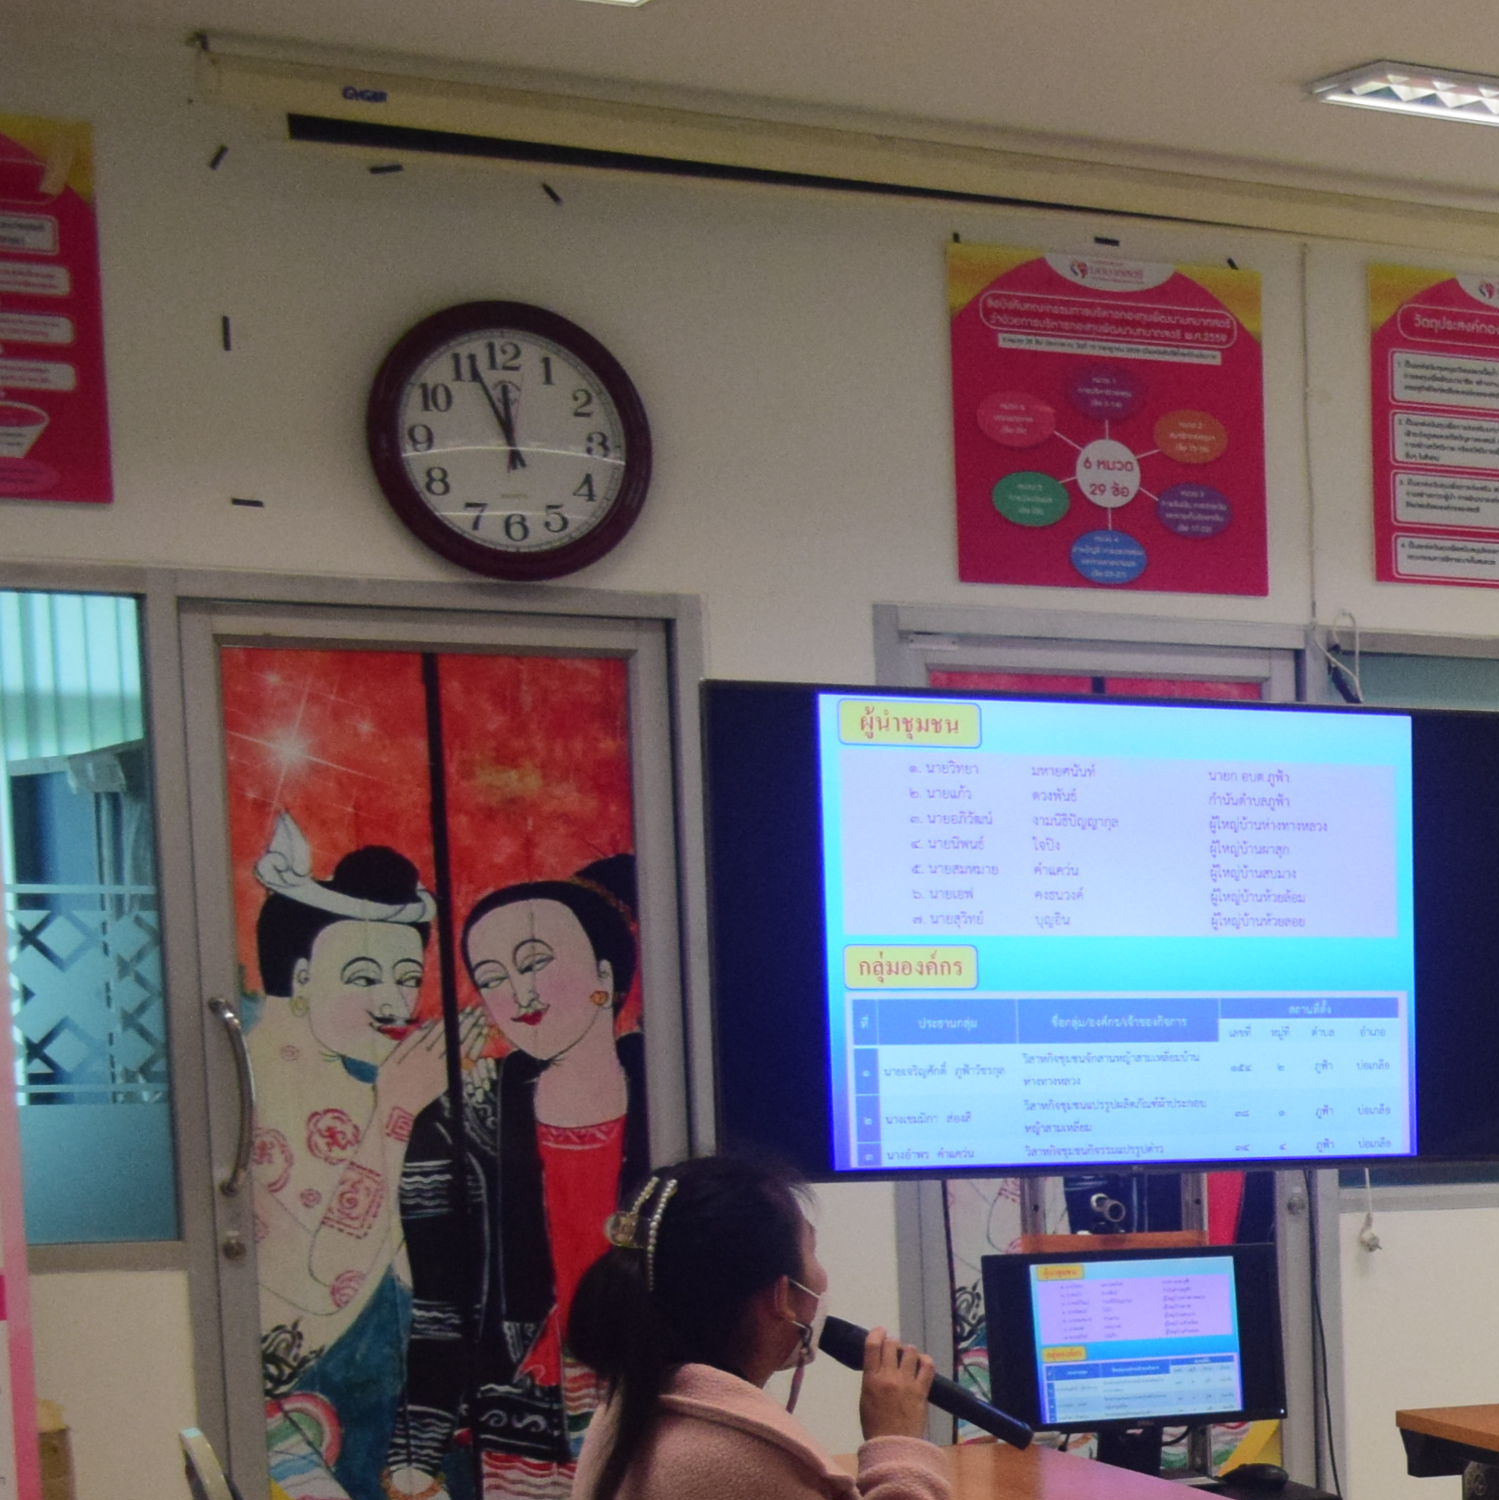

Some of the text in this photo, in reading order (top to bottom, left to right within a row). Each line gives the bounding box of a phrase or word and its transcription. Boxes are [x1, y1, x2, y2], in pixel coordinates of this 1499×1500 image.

[452, 353, 480, 383] 11
[486, 341, 522, 371] 12
[540, 356, 555, 385] 1
[418, 382, 453, 413] 10
[572, 389, 594, 418] 2
[407, 424, 434, 452] 9
[586, 431, 610, 458] 3
[1083, 457, 1135, 473] 6 หมวด
[425, 466, 450, 496] 8
[572, 472, 597, 502] 4
[1089, 482, 1131, 498] 29 ข้อ
[464, 502, 488, 531] 7
[504, 513, 530, 541] 6
[544, 504, 569, 533] 5
[860, 705, 960, 740] ผู้นำชุมชน
[925, 759, 980, 775] นายวิทยา
[926, 783, 972, 800] นายแก้ว
[1208, 792, 1291, 812] กำนันตำบลภูฟ้า
[927, 810, 993, 826] นายอภิวัฒน์
[1208, 815, 1328, 834] ผู้ใหญ่บ้านห่างทางหลวง
[928, 835, 985, 851] นายนิพนธ์
[928, 862, 999, 877] นายสมหมาย
[930, 910, 985, 929] นายสุวิทย์
[859, 950, 964, 983] กลุ่มองค์กร
[918, 1016, 978, 1031] ประธานกลุ่ม
